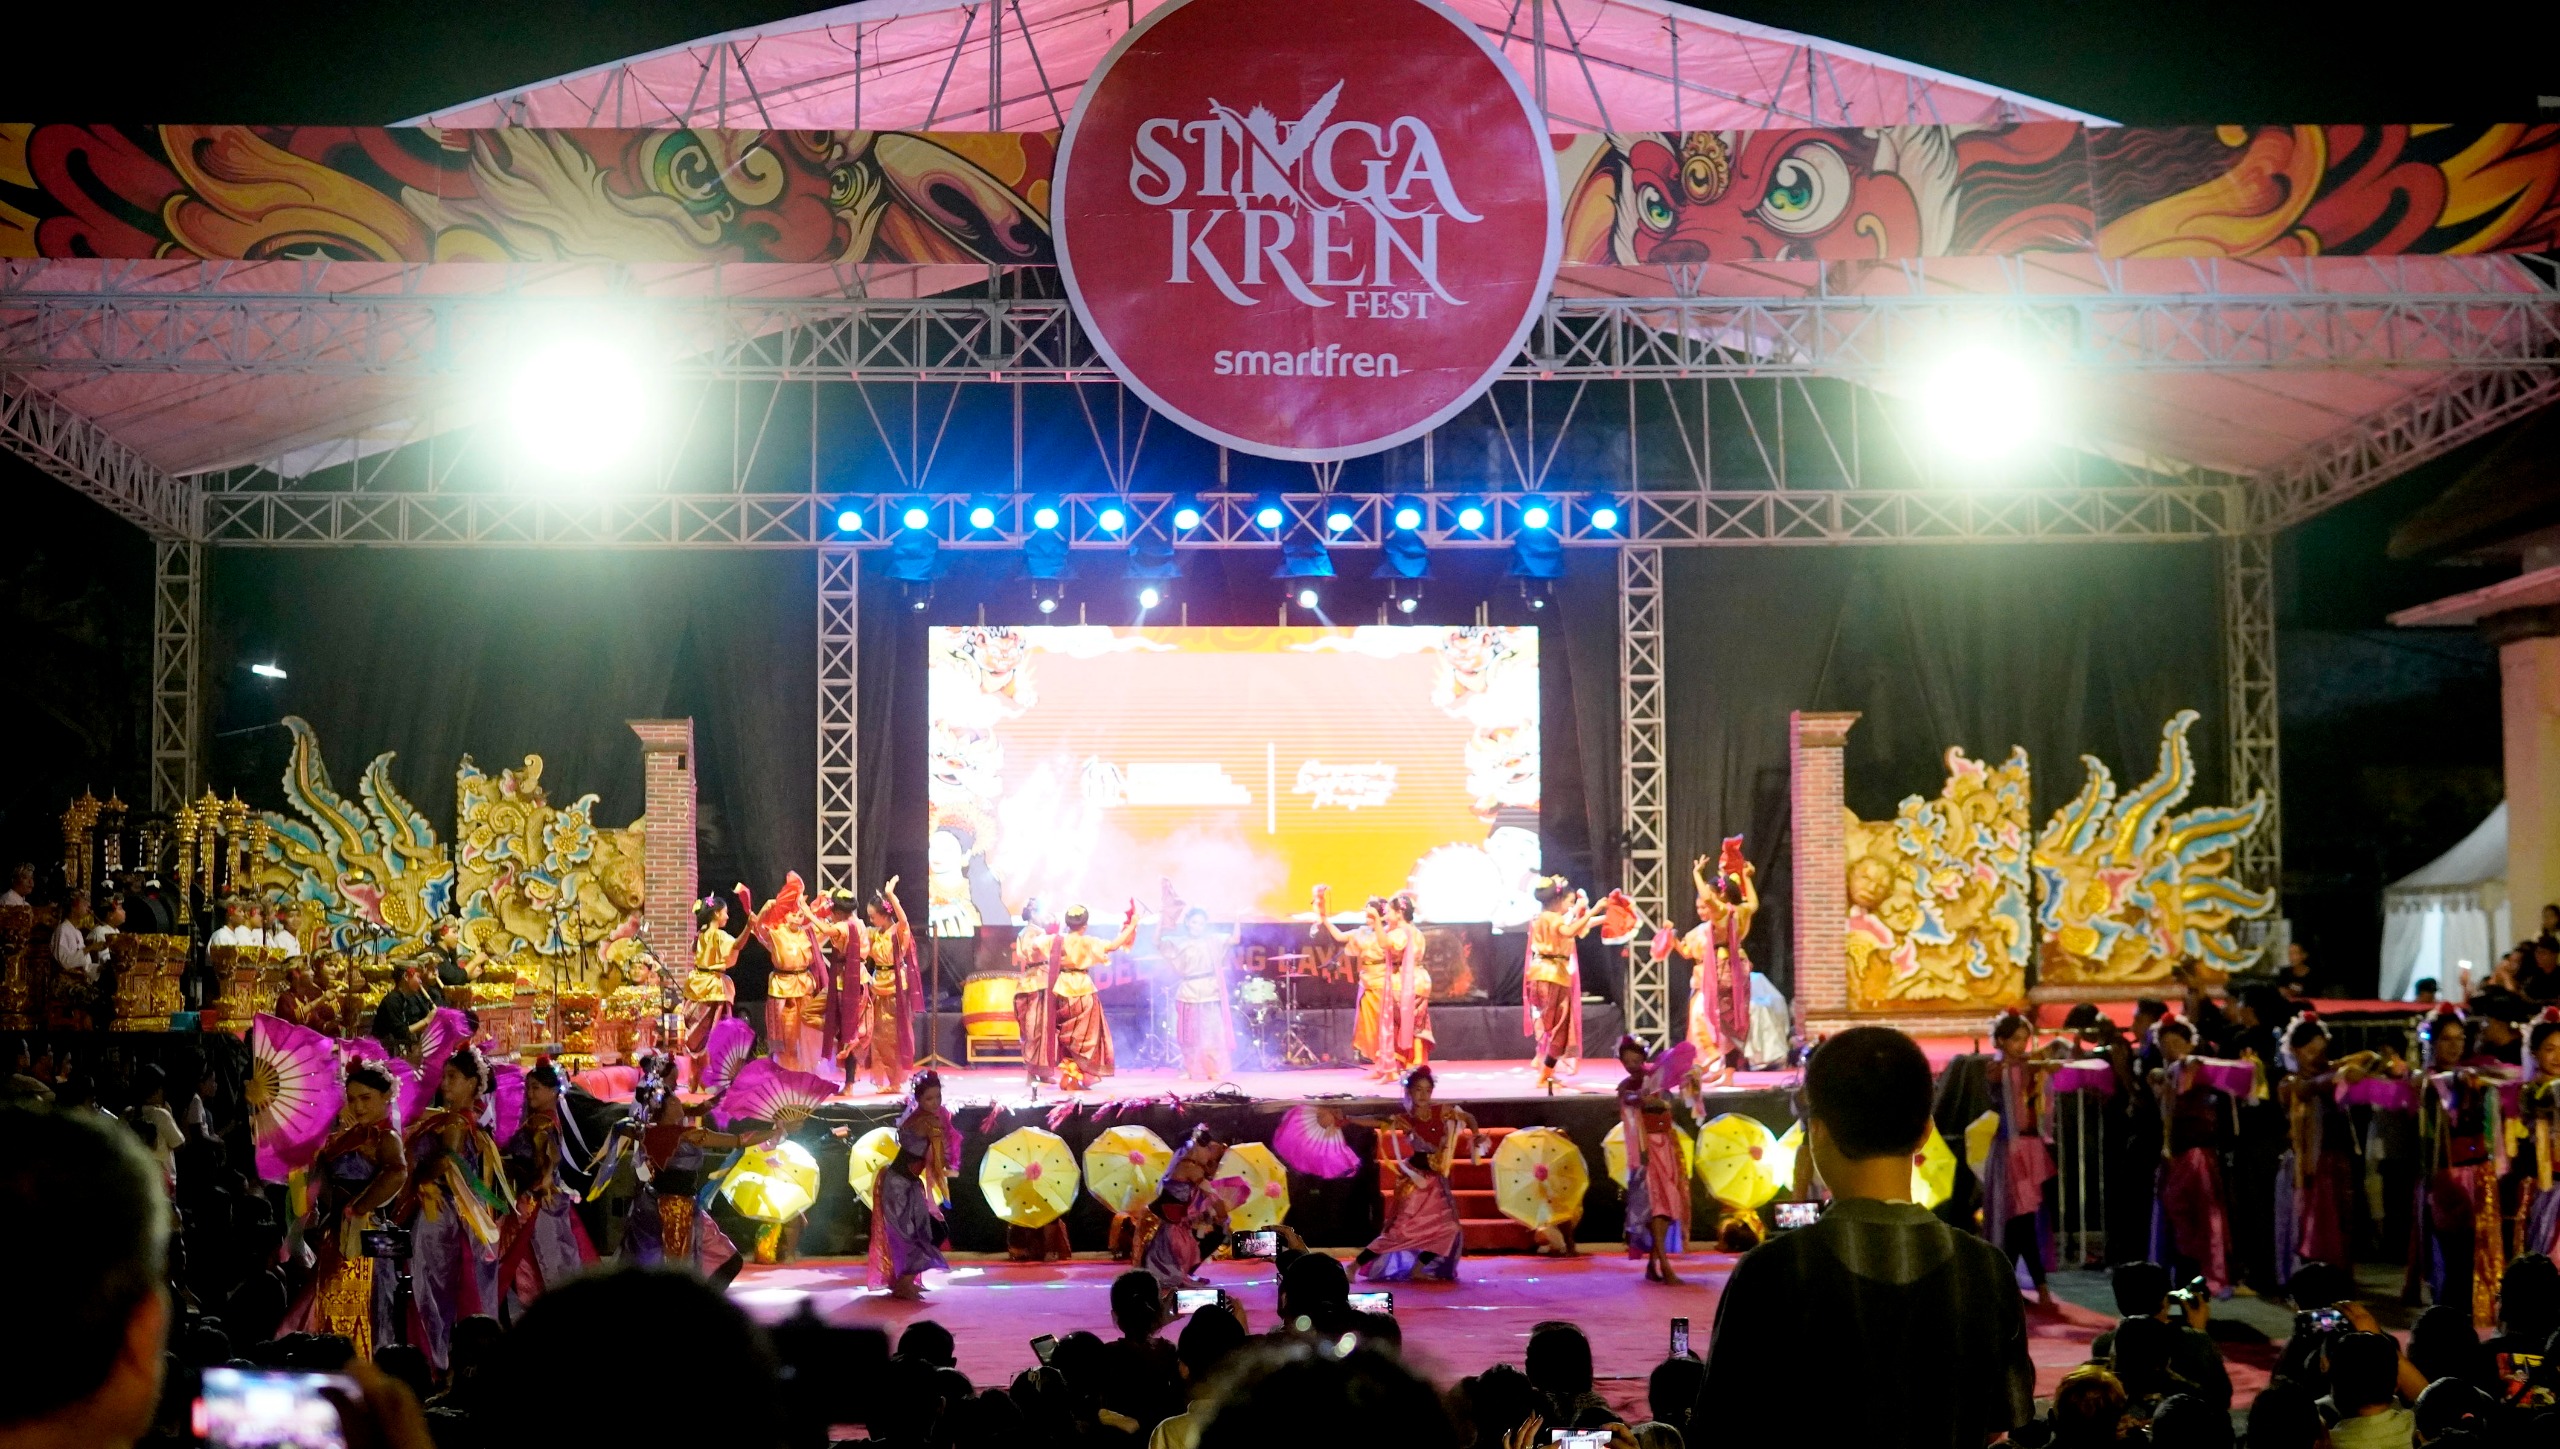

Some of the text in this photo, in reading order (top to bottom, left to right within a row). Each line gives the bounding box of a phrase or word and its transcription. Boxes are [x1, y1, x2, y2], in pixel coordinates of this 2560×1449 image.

[1129, 98, 1484, 223] SINGA
[1165, 200, 1470, 308] KREN
[1344, 291, 1434, 320] FEST
[1213, 343, 1398, 378] smartfren
[1278, 945, 1366, 985] LAYA
